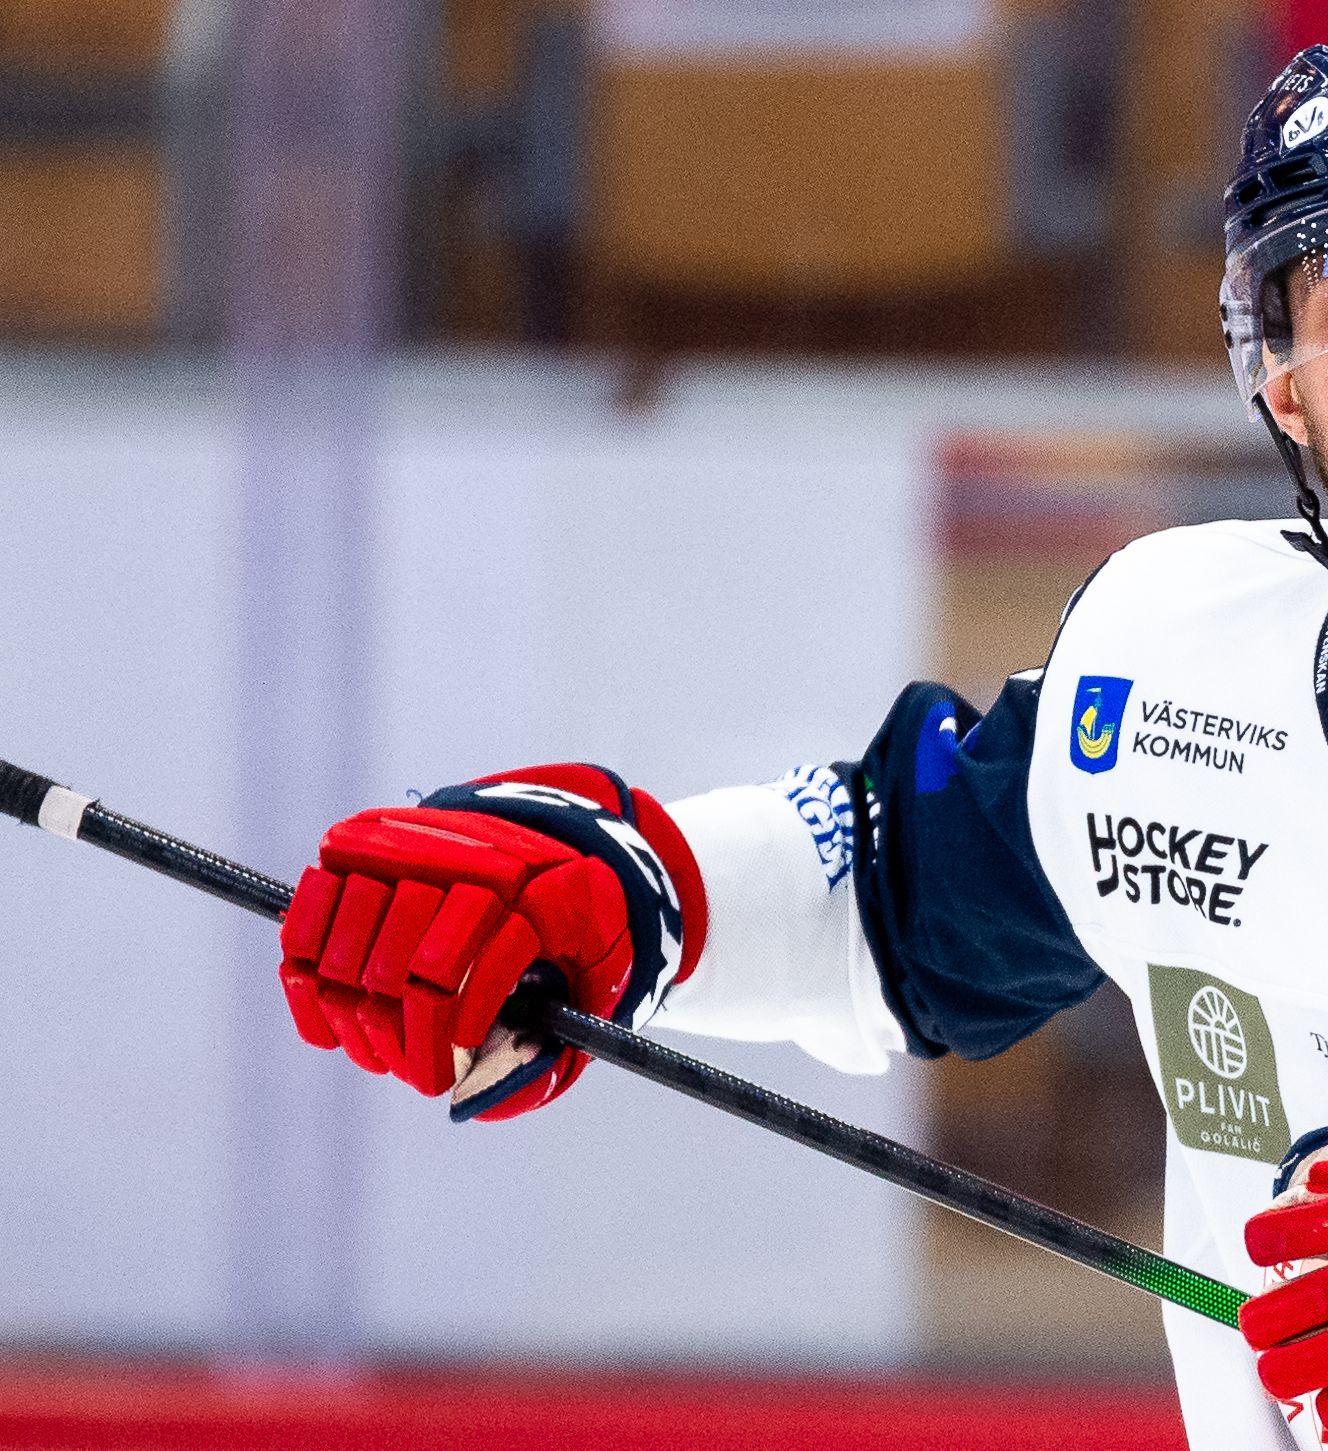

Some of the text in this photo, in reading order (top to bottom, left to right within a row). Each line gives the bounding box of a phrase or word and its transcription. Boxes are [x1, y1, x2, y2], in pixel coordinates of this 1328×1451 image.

[1141, 700, 1289, 752] VÄSTERVIKS
[1132, 731, 1245, 774] KOMMUN
[1087, 812, 1270, 881] HOCKEY
[1174, 1077, 1271, 1128] PLIVIT
